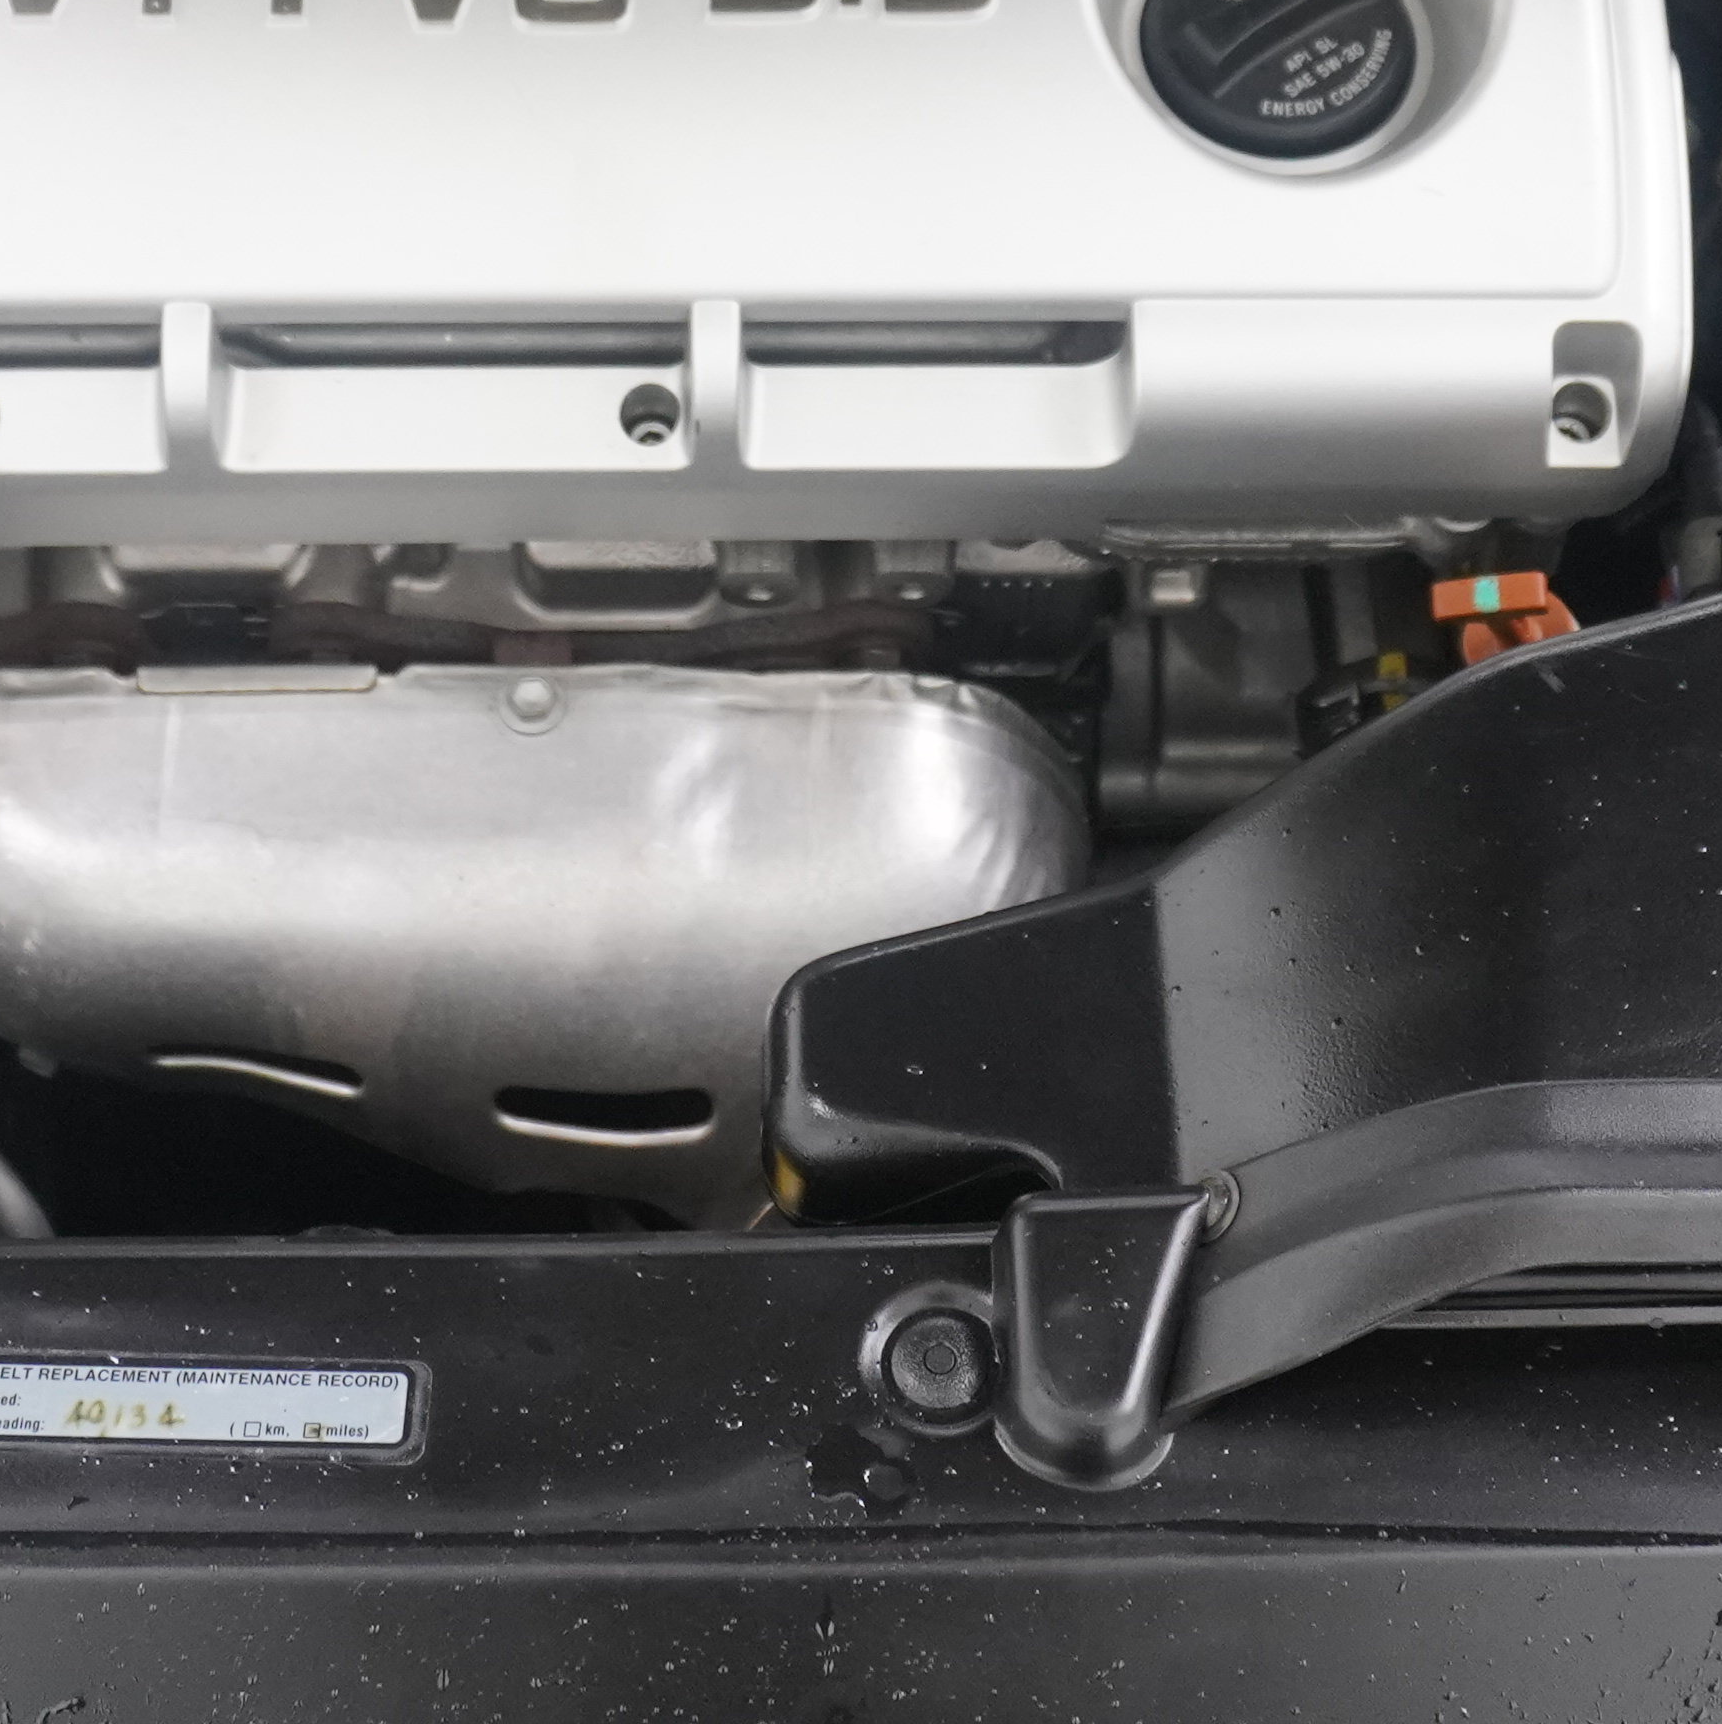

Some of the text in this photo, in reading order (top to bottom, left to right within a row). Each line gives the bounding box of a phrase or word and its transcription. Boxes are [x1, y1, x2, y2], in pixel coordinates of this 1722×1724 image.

[1285, 50, 1312, 72] API
[1260, 28, 1392, 117] ENERGY CONSERVING
[1283, 72, 1317, 98] SAE
[38, 1368, 172, 1383] REPLACEMENT
[176, 1370, 313, 1387] (MAINTENANCE
[318, 1373, 399, 1390] RECORD)
[326, 1424, 370, 1439] miles)
